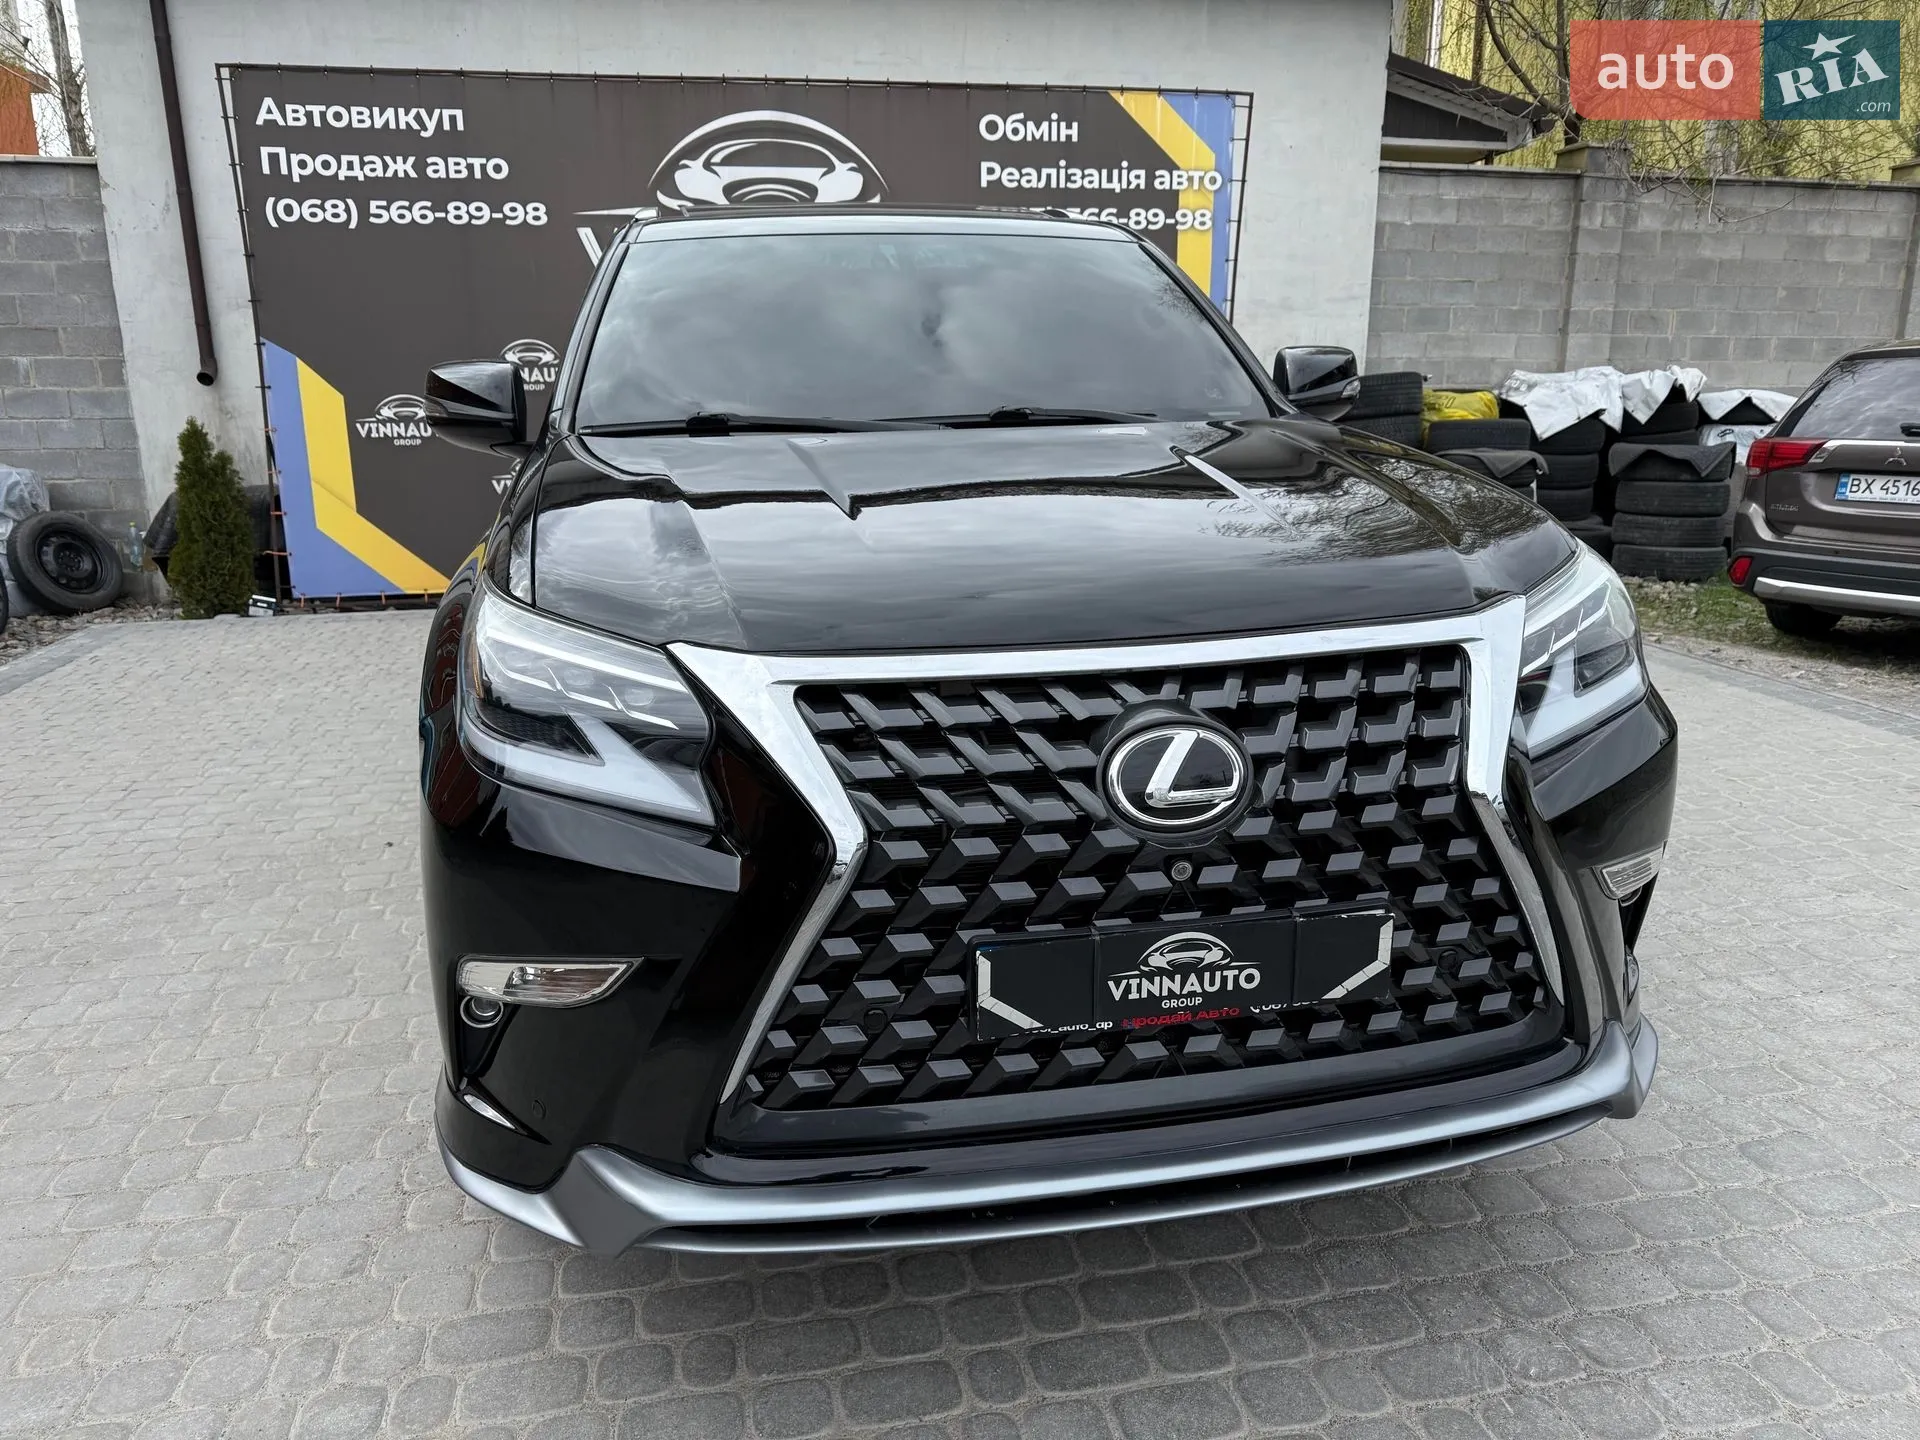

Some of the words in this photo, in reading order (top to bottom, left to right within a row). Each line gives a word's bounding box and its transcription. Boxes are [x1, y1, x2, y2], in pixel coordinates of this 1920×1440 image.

[256, 97, 464, 137] Автовикуп
[978, 112, 1079, 142] Обмін
[260, 146, 418, 182] Продаж
[425, 155, 509, 180] авто
[980, 159, 1146, 193] Реалізація
[1153, 168, 1223, 191] авто
[265, 197, 359, 229] (068)
[368, 200, 549, 226] 566-89-98
[393, 438, 422, 446] GROUP
[1107, 968, 1261, 1001] VINNAUTO
[1161, 997, 1203, 1009] GROUP
